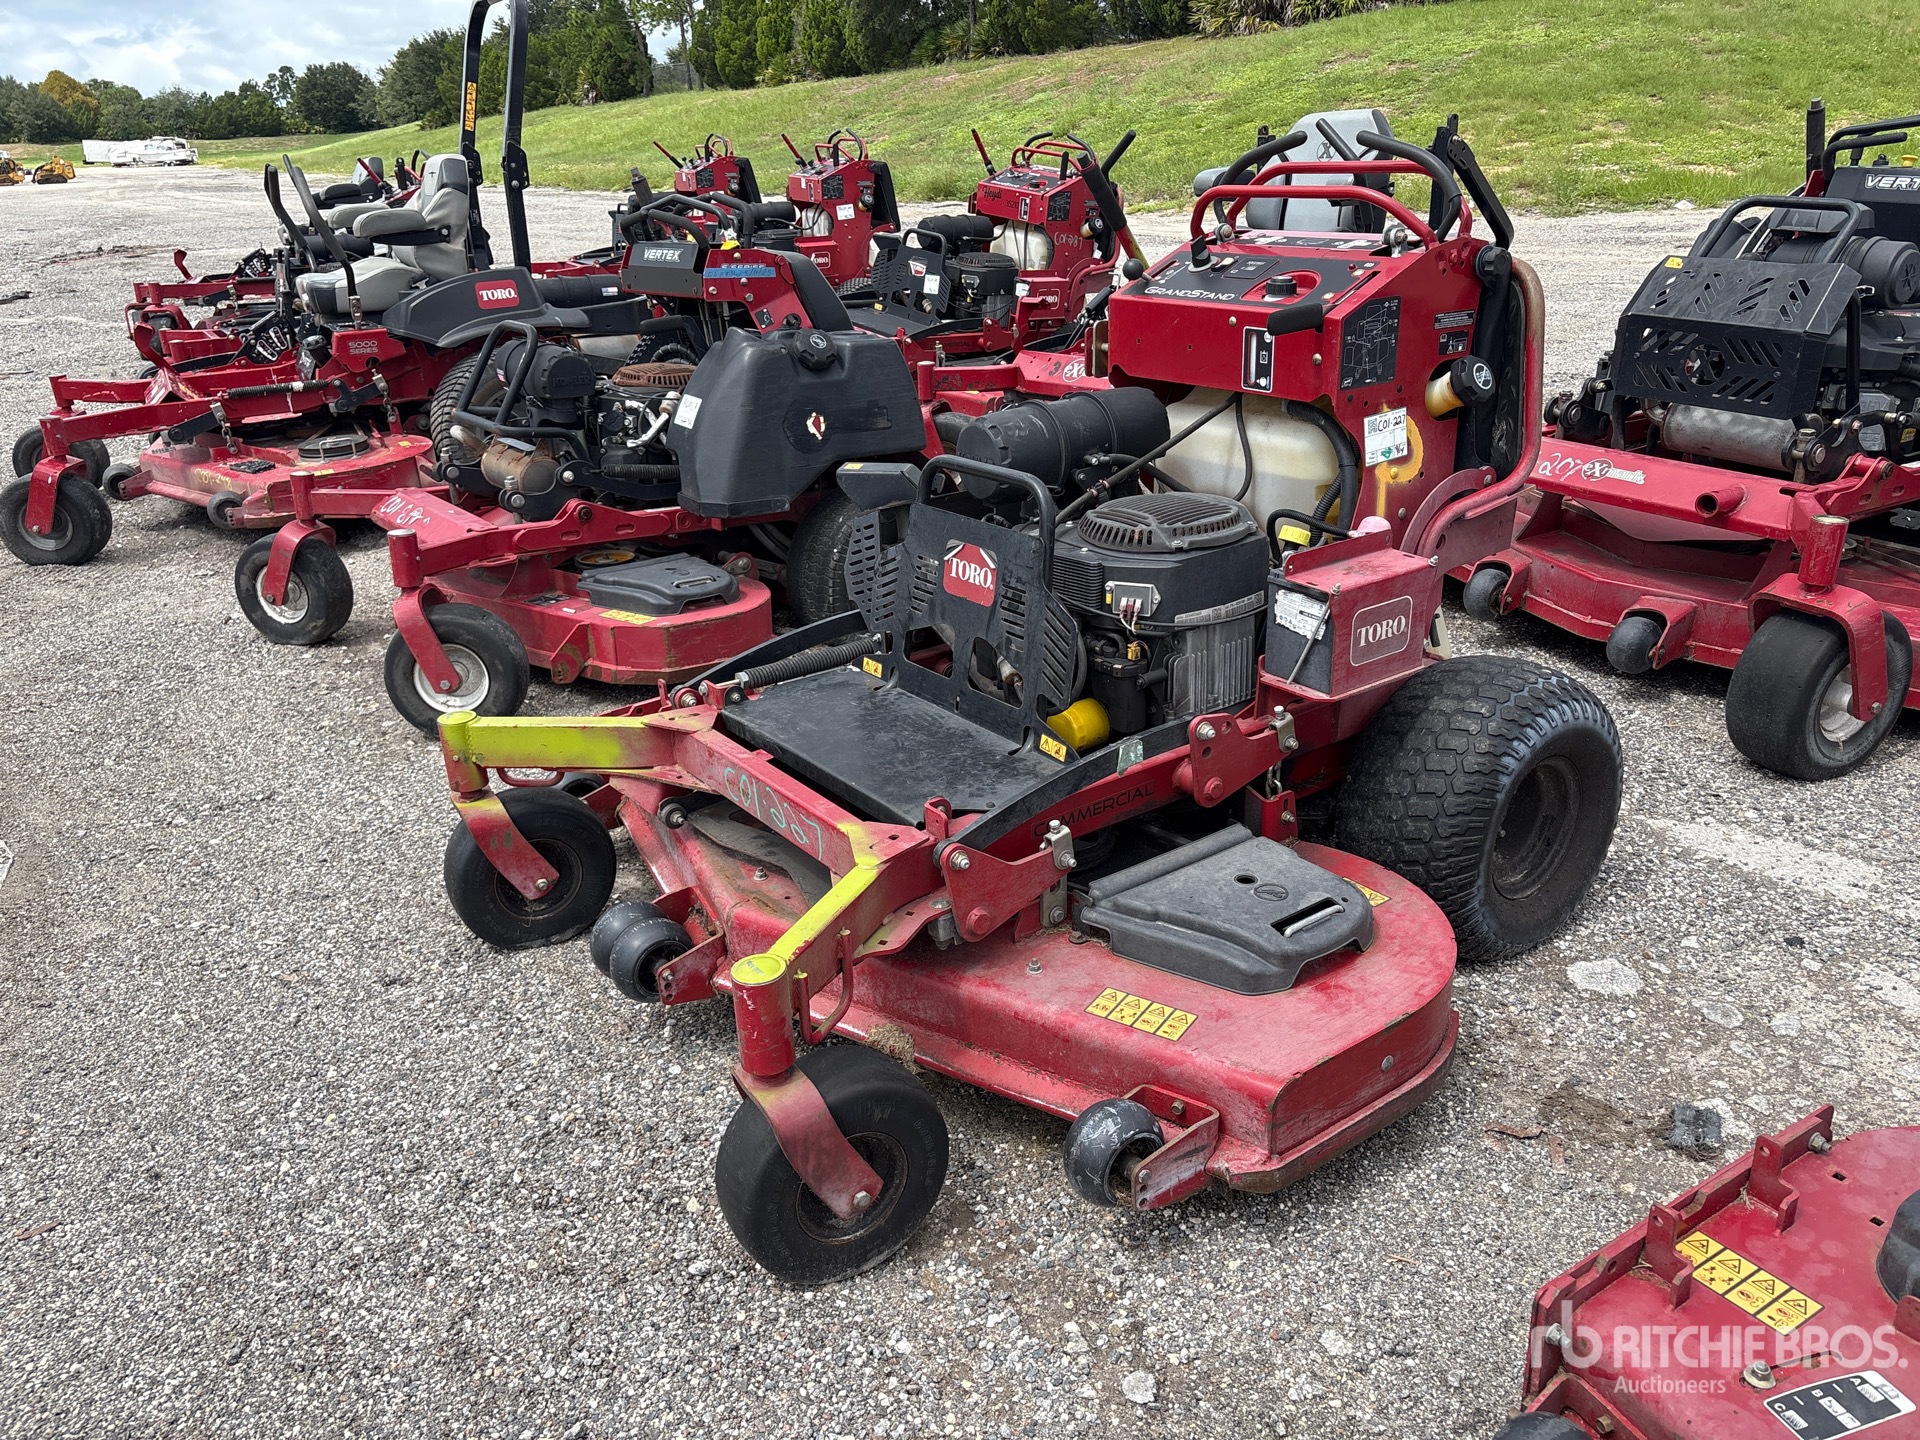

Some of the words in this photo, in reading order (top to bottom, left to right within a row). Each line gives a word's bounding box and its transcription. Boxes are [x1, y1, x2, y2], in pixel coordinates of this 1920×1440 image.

[643, 248, 684, 262] VERTEX
[479, 288, 517, 301] TORO
[349, 340, 378, 348] 5000
[350, 347, 379, 355] SERIES
[552, 375, 591, 386] KOHLER
[949, 557, 992, 588] TORO
[1357, 615, 1406, 647] TORO
